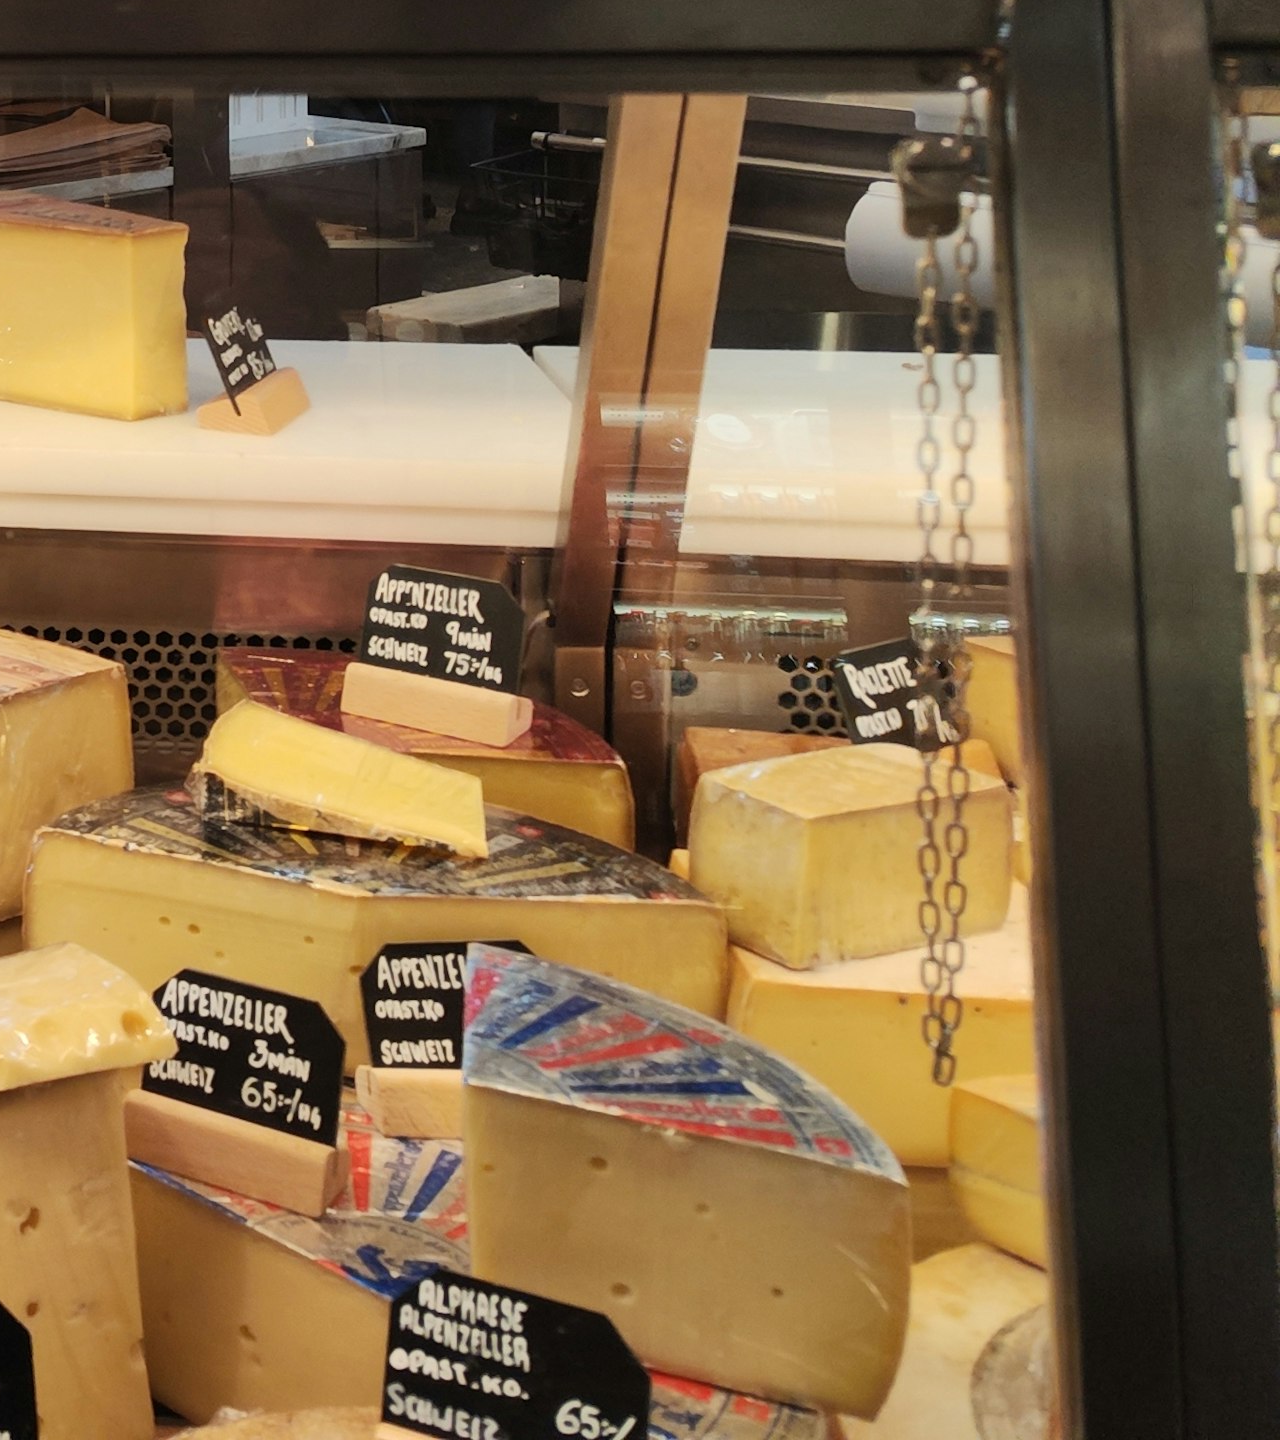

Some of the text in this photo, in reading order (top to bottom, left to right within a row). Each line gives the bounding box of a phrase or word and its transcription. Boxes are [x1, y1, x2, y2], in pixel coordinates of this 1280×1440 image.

[368, 635, 428, 667] SCHWEIZ
[161, 977, 295, 1044] APPENZELLER
[381, 1039, 456, 1065] SCHWEIZ
[418, 1279, 528, 1333] ALPKAESE
